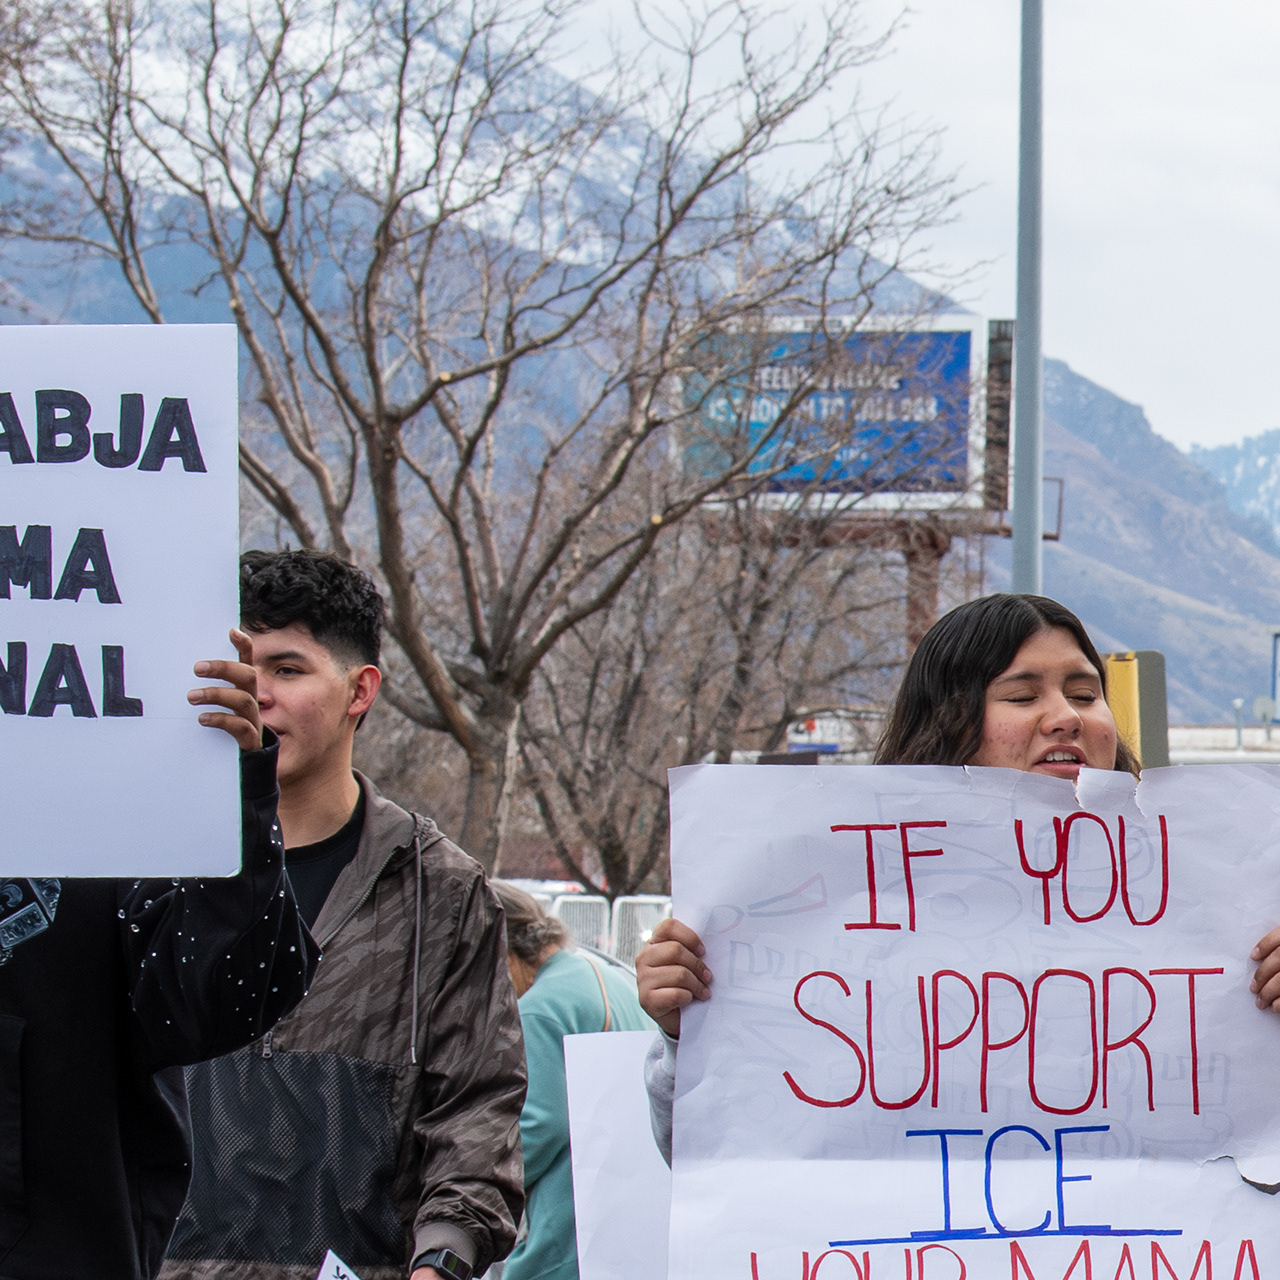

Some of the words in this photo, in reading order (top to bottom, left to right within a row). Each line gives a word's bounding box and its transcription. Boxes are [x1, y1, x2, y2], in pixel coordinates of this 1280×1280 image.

[831, 821, 947, 931] IF
[1015, 811, 1168, 926] YOU
[783, 968, 1224, 1115] SUPPORT
[907, 1125, 1111, 1236] ICE
